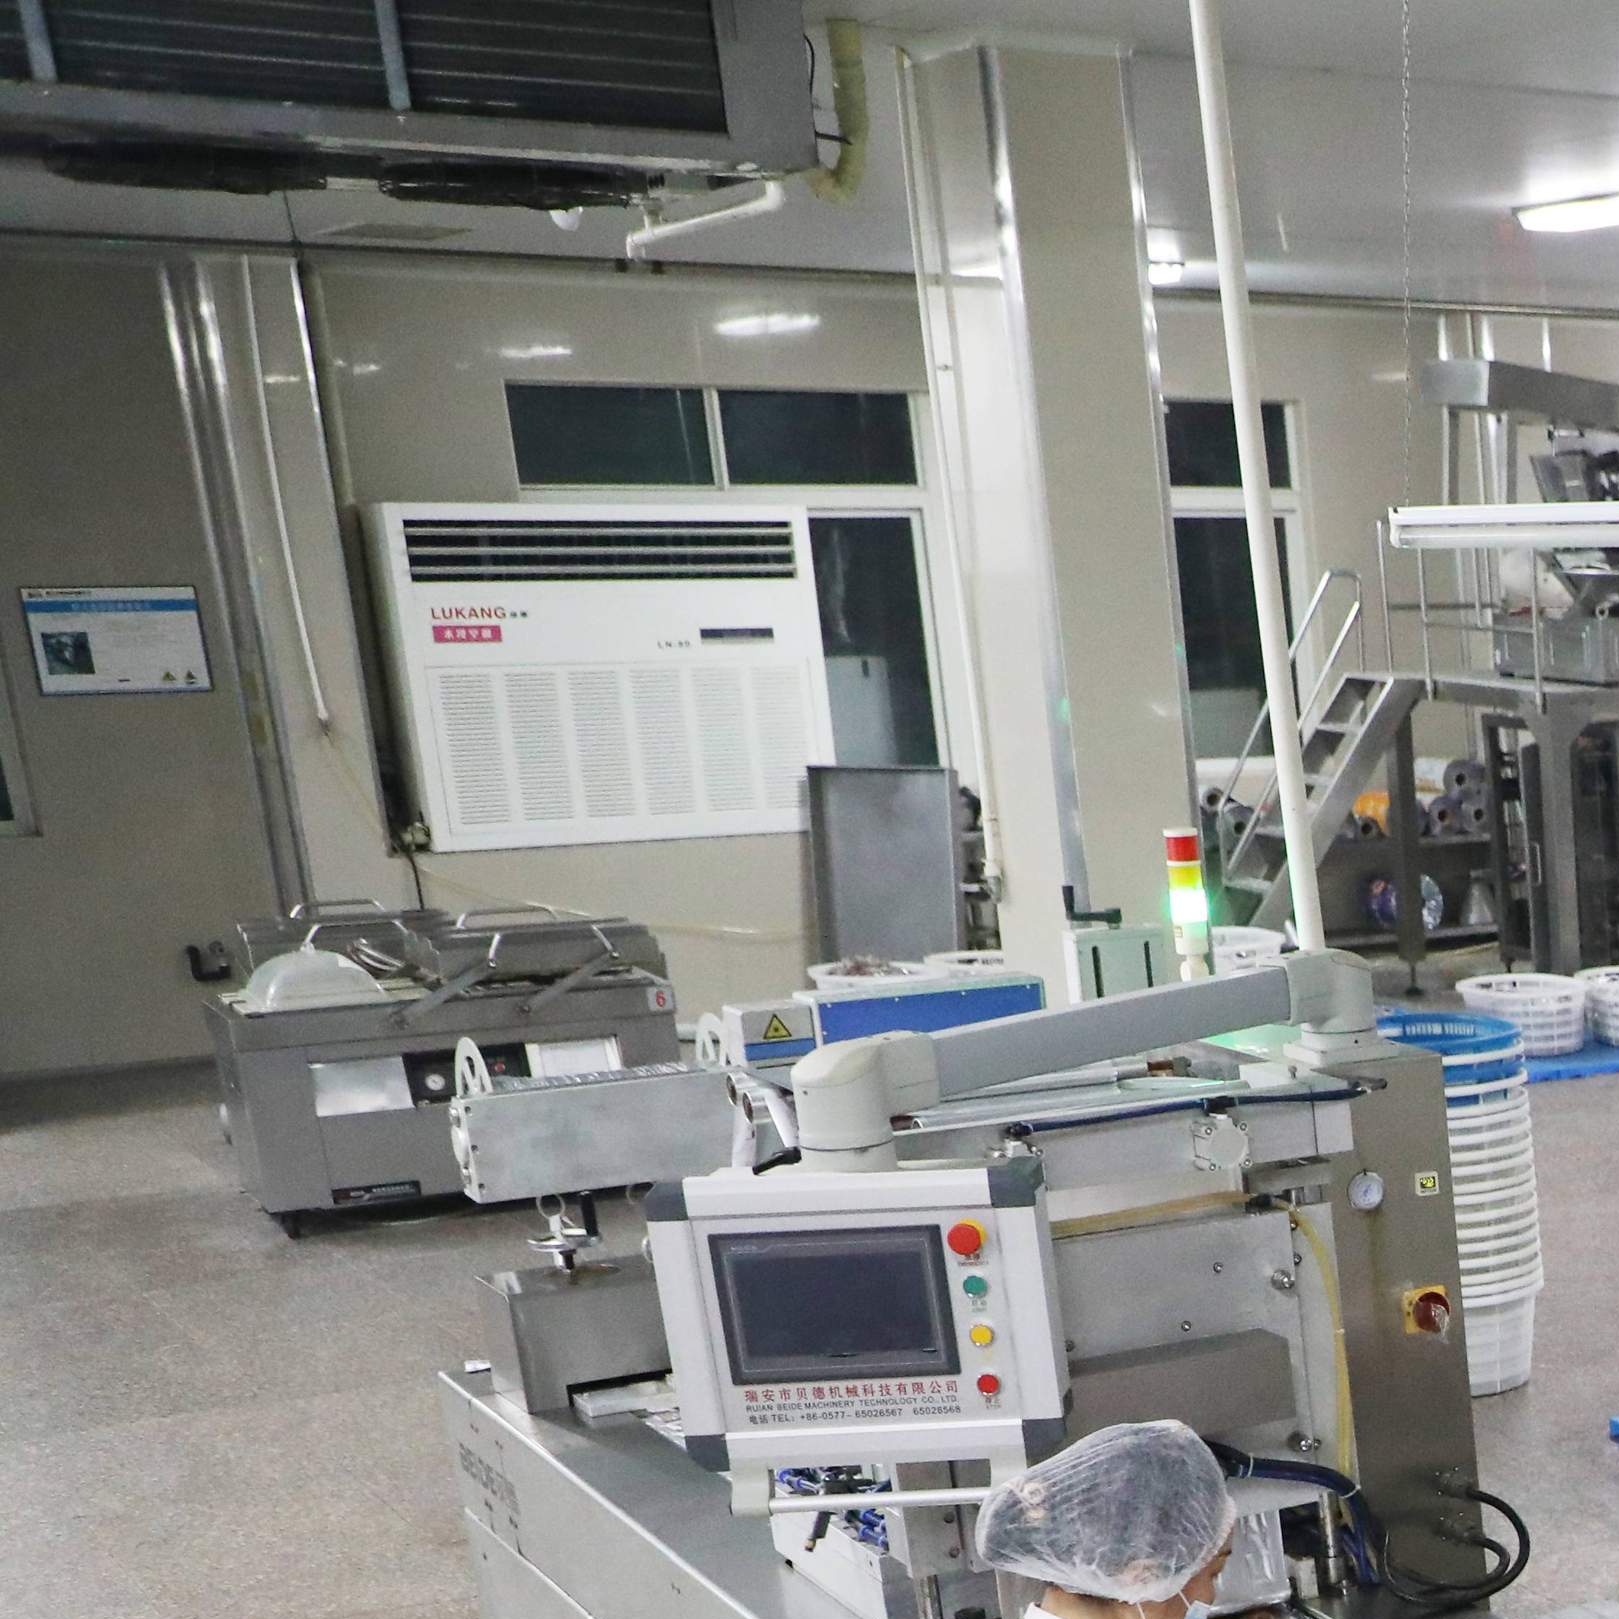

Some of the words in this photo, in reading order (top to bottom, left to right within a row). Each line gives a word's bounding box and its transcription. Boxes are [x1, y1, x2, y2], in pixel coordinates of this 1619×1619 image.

[431, 606, 506, 620] LUKANG
[655, 991, 666, 1008] 6
[744, 1380, 959, 1403] 瑞安市贝德机械科技有限公司
[746, 1403, 773, 1413] RUIAN
[777, 1402, 802, 1411] BEIDE
[804, 1400, 855, 1410] MACHINERY
[860, 1397, 917, 1407] TECHNOLOGY
